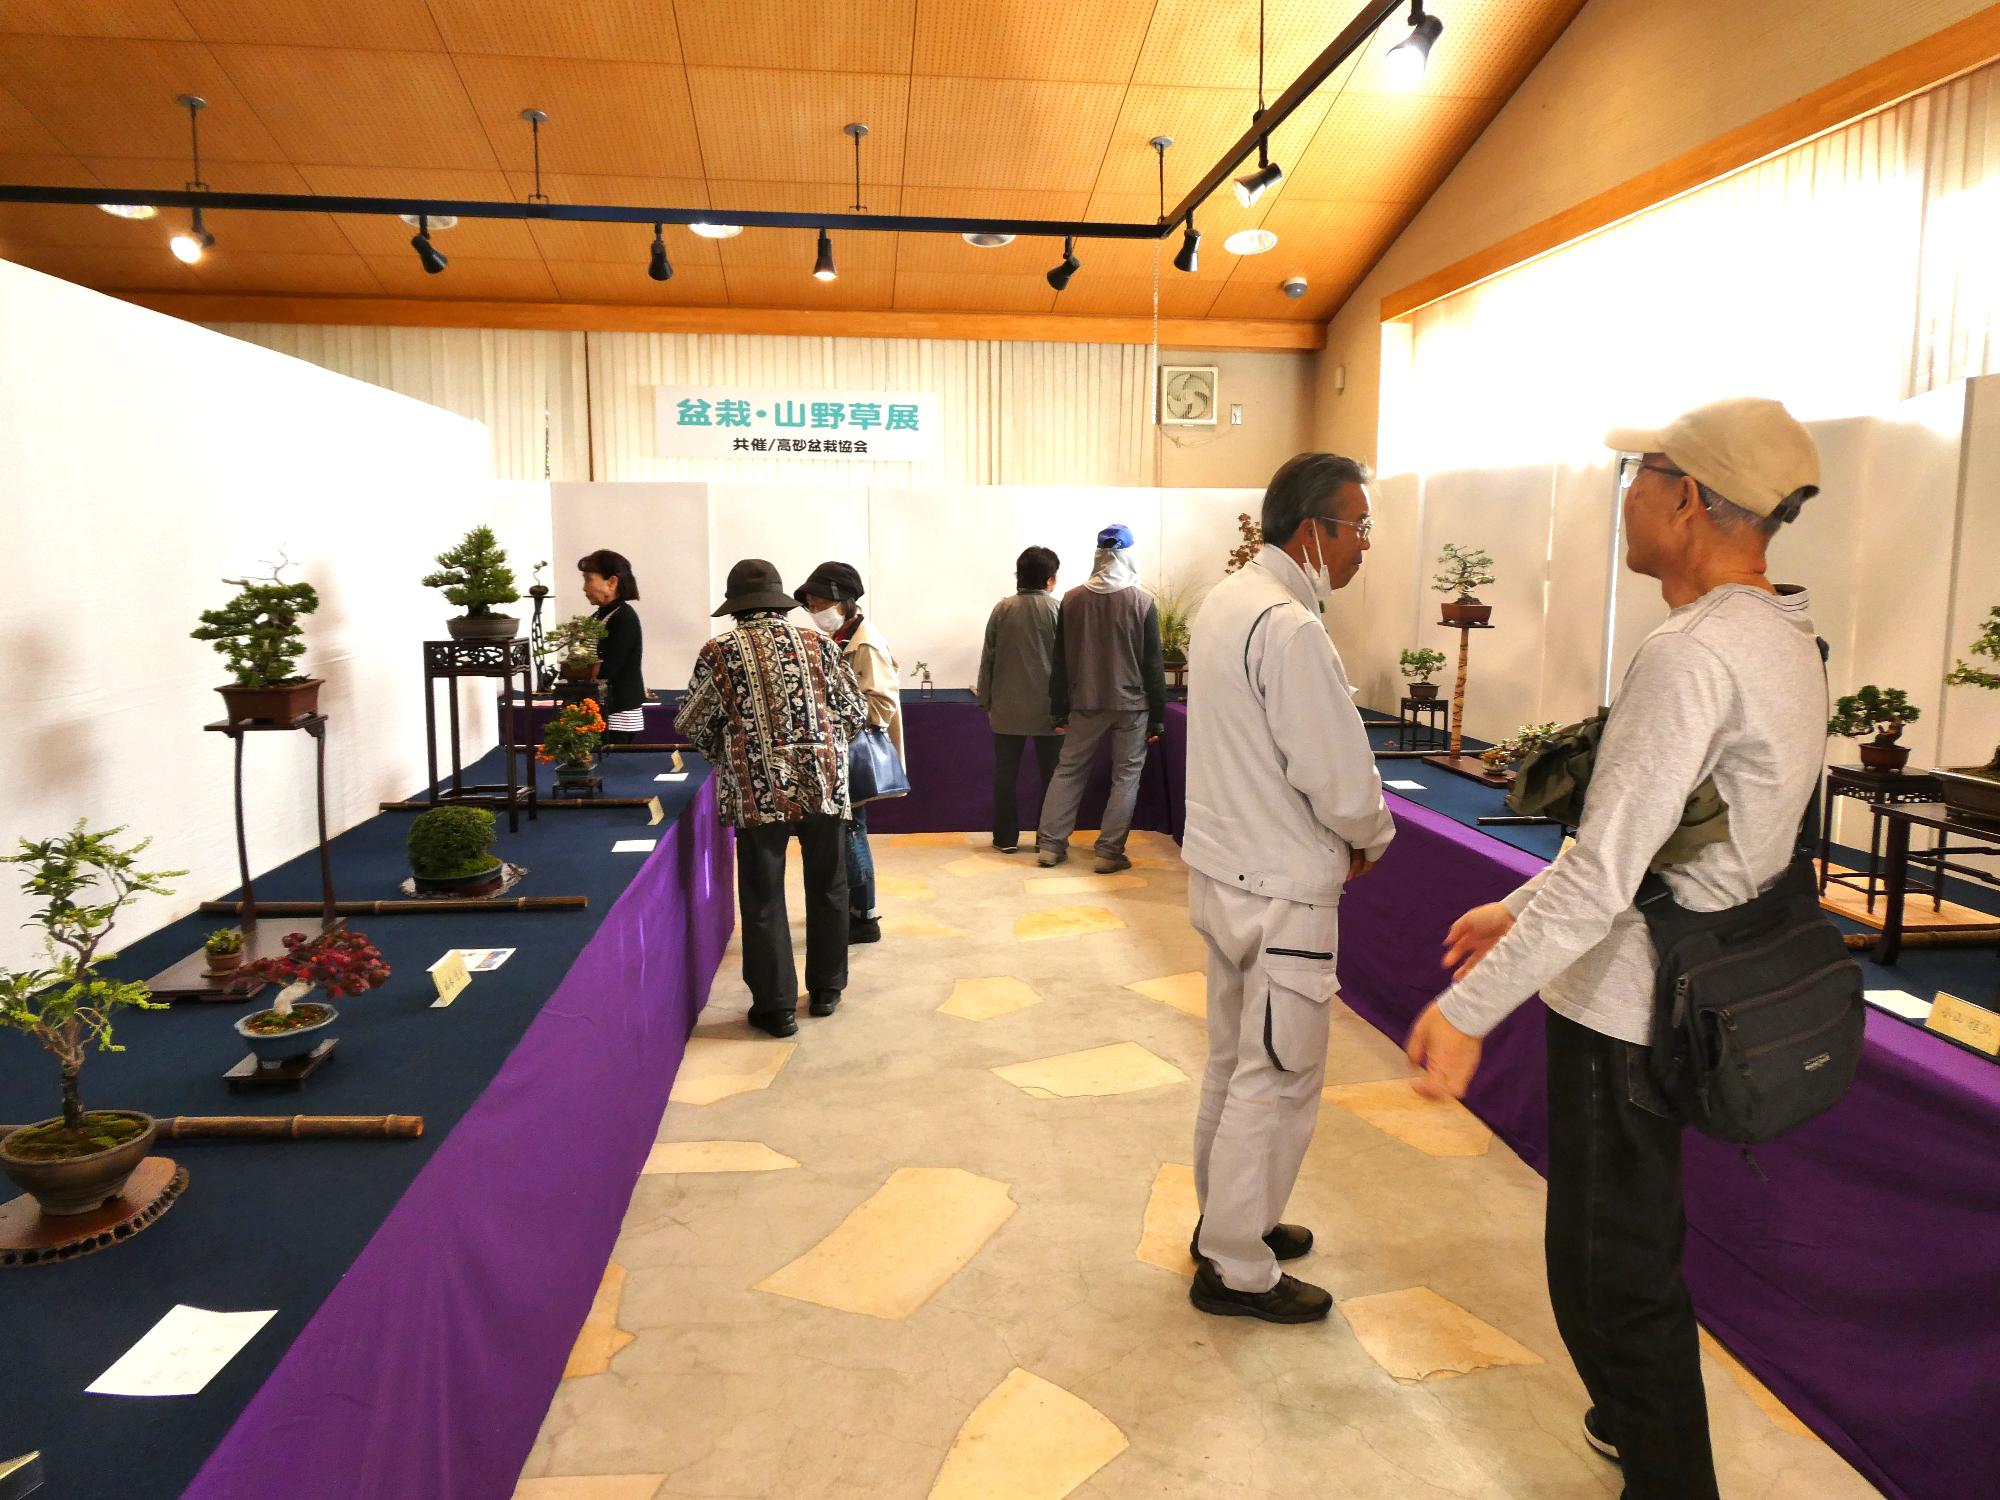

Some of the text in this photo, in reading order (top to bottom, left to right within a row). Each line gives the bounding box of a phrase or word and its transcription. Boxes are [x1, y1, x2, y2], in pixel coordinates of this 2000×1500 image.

[677, 398, 919, 431] 盆栽・山野草展
[733, 438, 868, 453] 共催/高砂盆栽協会
